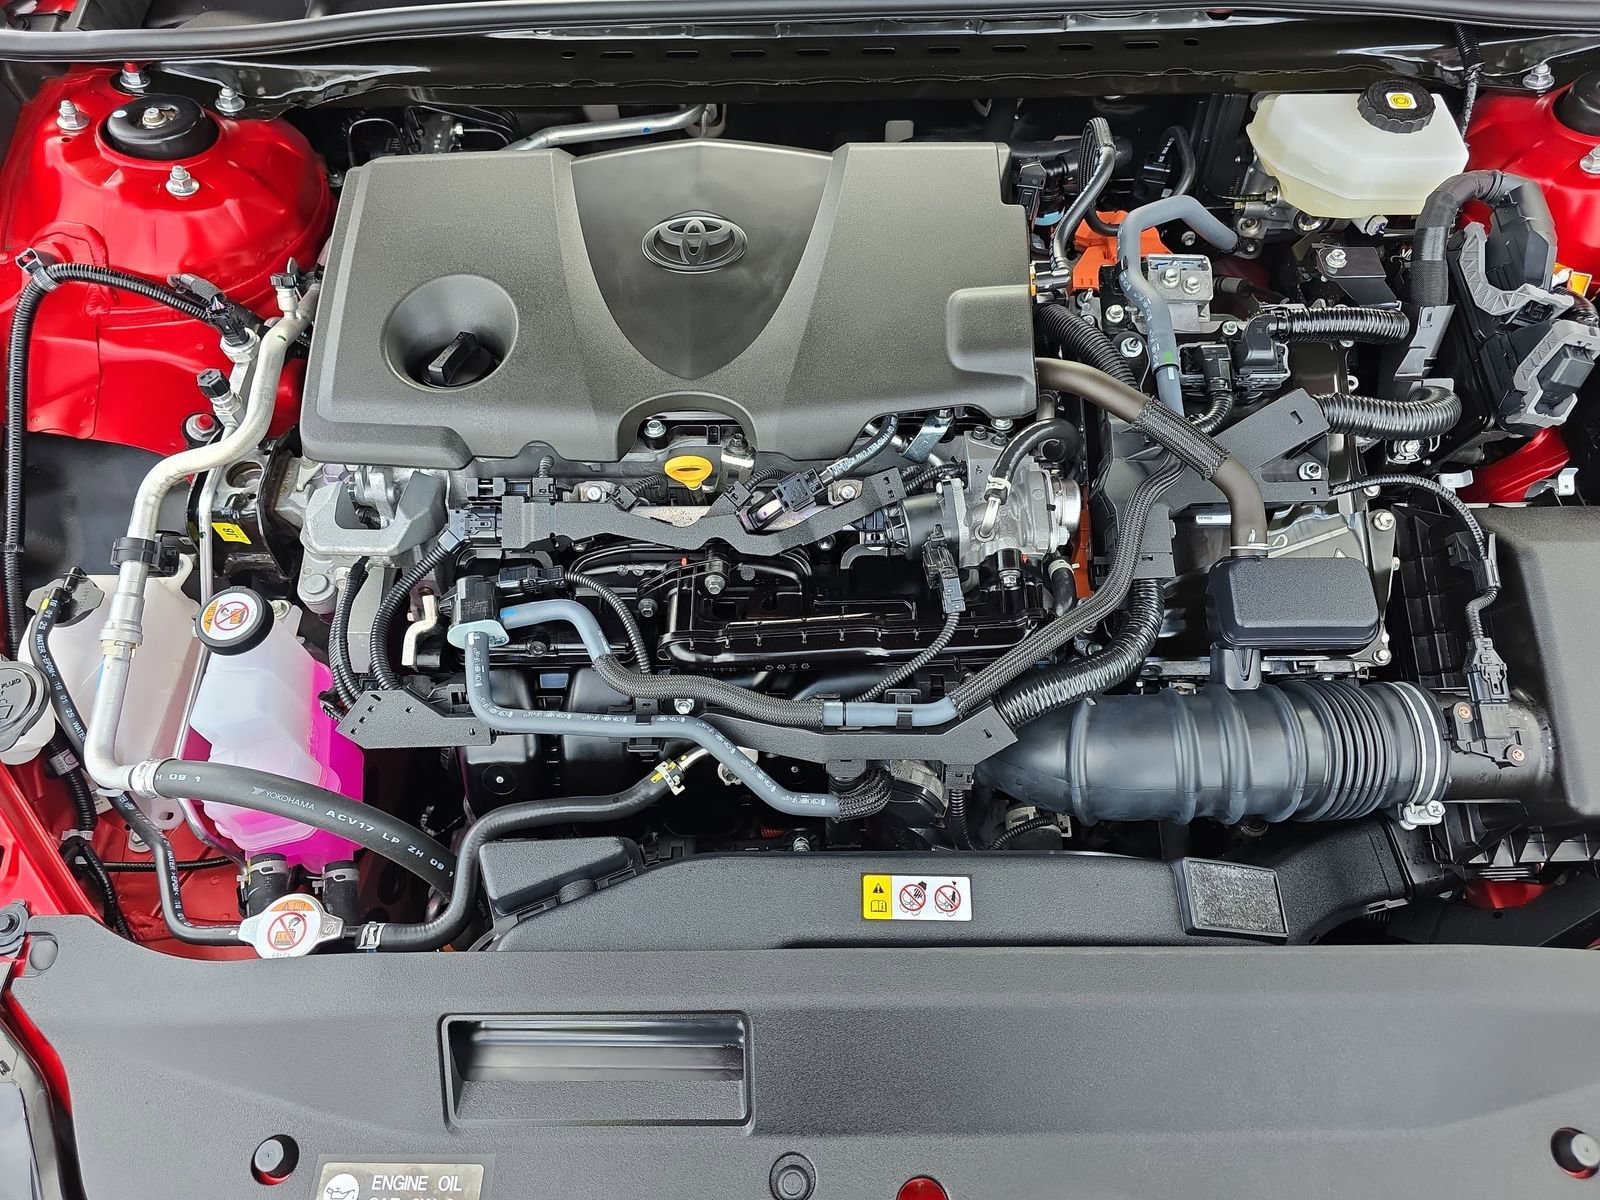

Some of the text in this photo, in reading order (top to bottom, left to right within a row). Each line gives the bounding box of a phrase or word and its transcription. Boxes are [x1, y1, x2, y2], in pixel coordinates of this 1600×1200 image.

[36, 634, 46, 654] WATER
[65, 708, 75, 718] 25
[265, 790, 315, 811] YOKOHAMA
[326, 809, 375, 832] ACV17
[382, 832, 400, 845] LP
[407, 845, 424, 858] ZH
[429, 858, 446, 871] 09
[371, 1175, 463, 1192] ENGINE OIL
